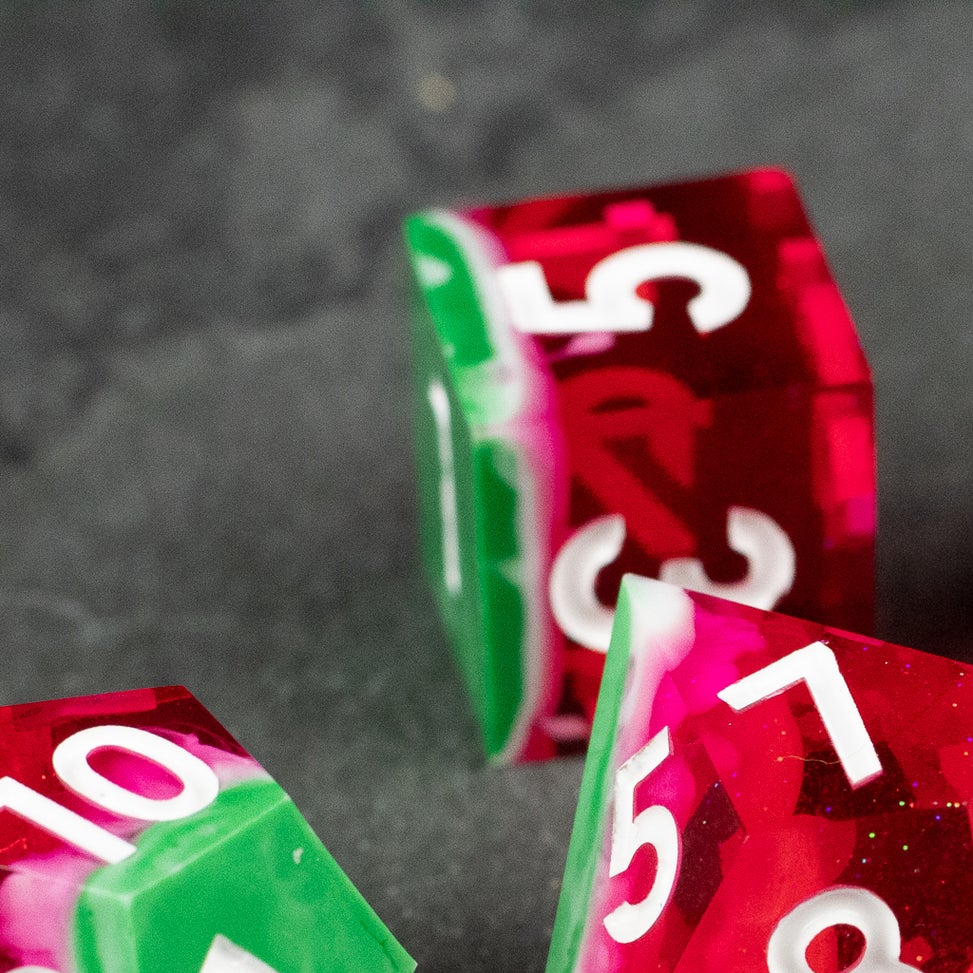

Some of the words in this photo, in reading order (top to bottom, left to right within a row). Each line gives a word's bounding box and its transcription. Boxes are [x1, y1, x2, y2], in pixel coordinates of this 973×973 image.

[498, 241, 751, 333] 5
[716, 640, 884, 789] 7
[603, 726, 675, 943] 5
